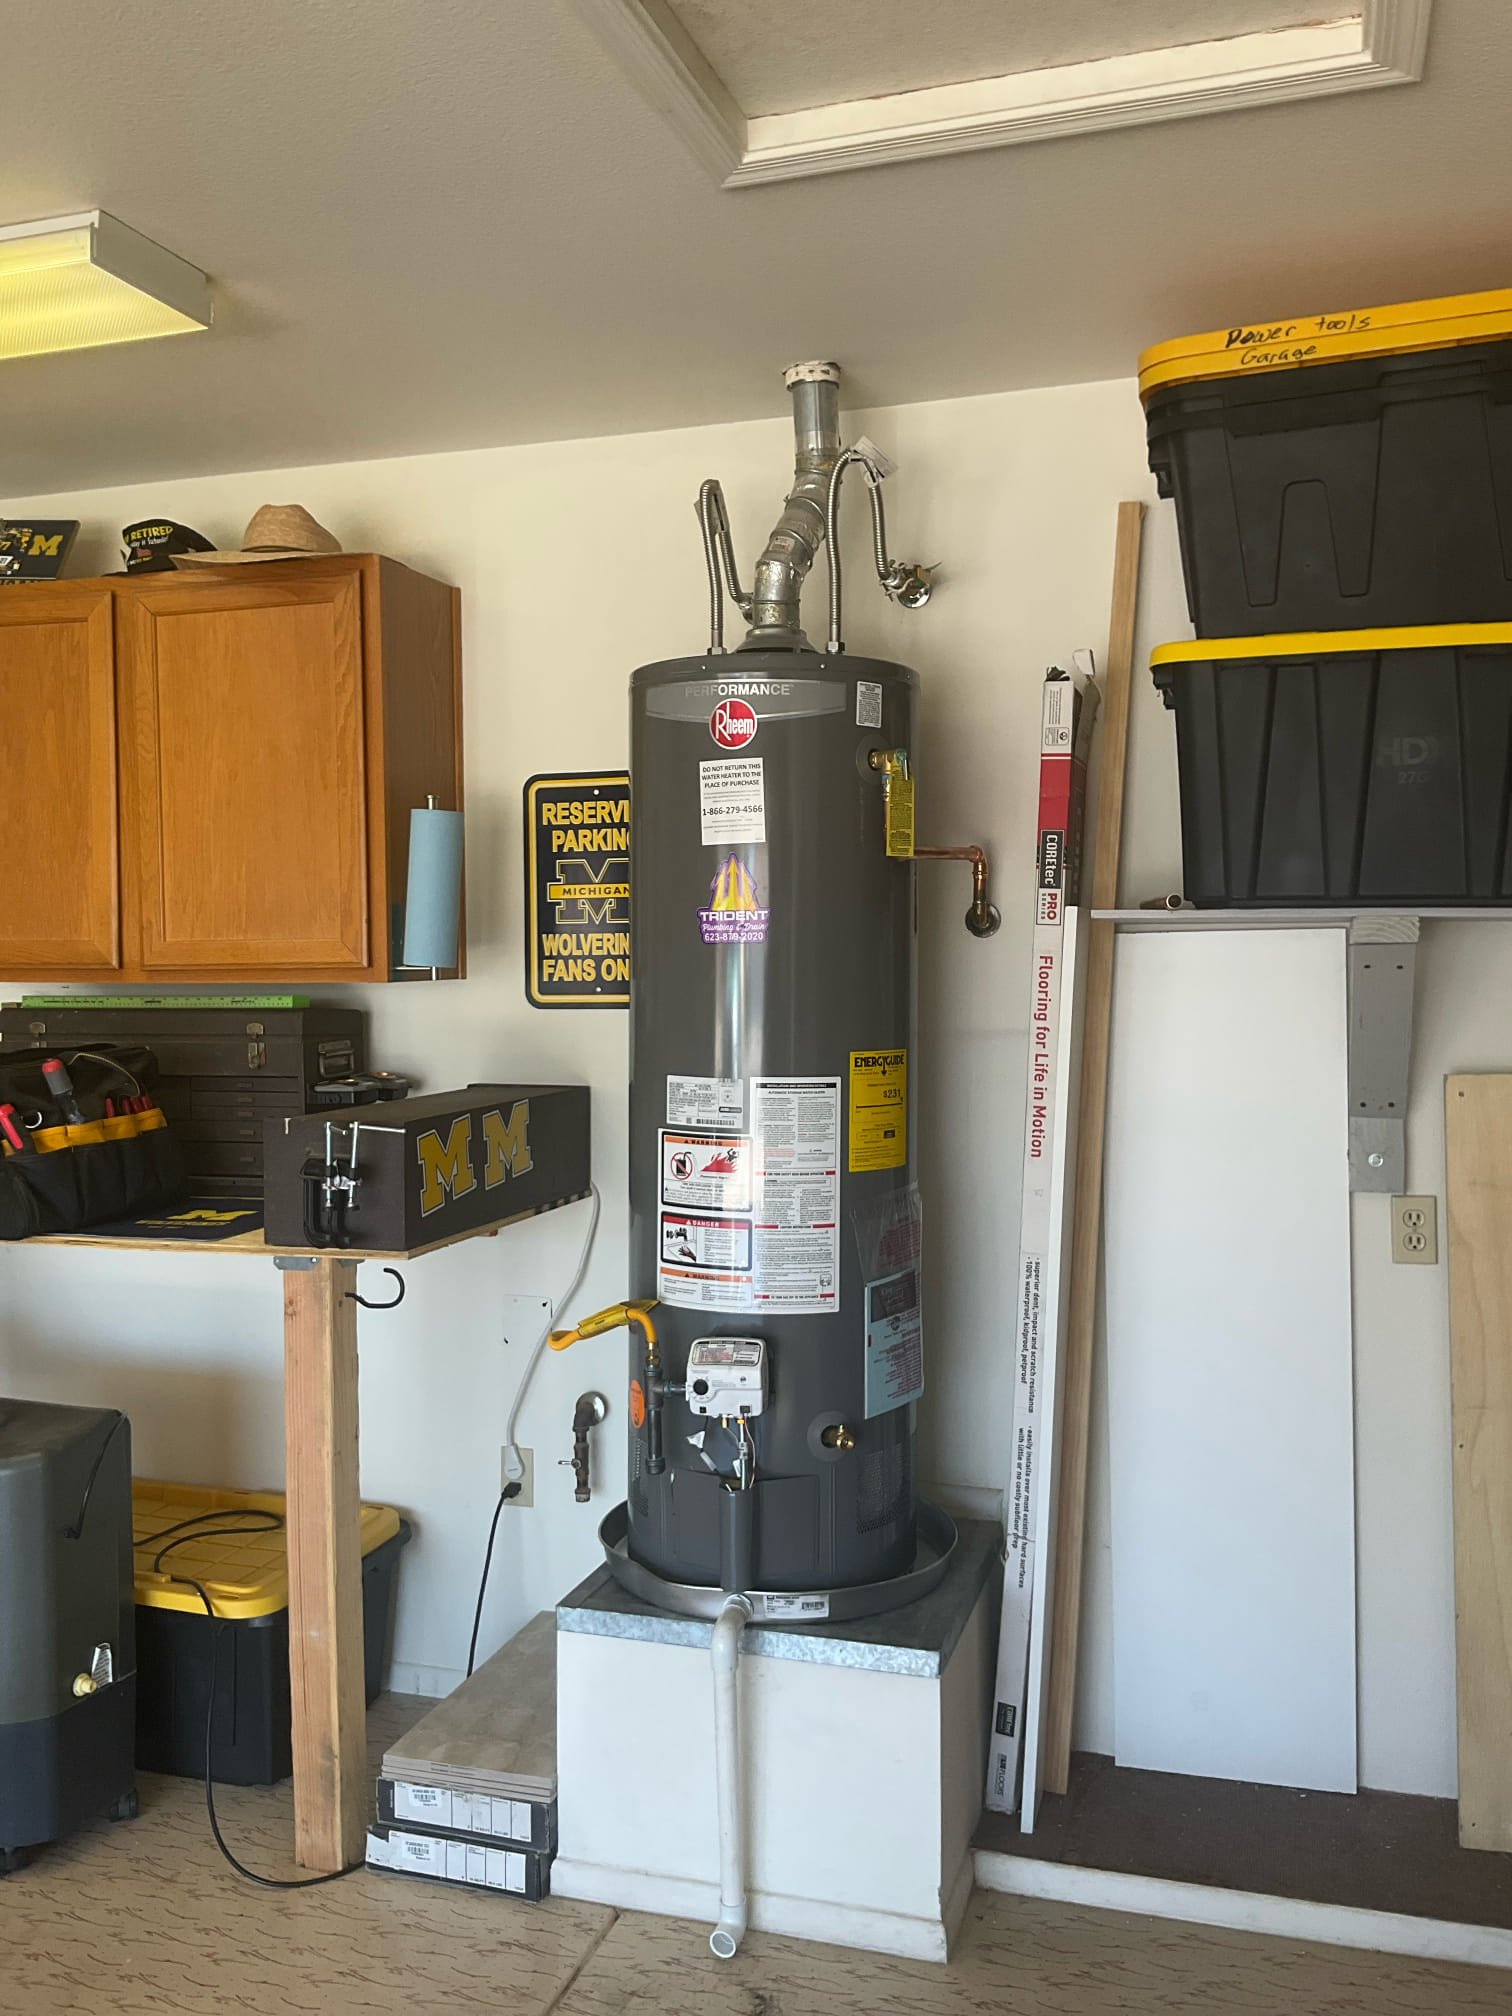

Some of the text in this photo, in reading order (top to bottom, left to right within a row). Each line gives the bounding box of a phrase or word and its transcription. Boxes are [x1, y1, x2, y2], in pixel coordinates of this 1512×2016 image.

[1314, 314, 1371, 332] tools
[1241, 345, 1317, 365] Garage
[131, 525, 174, 541] RETIRED
[28, 534, 64, 556] M
[685, 683, 791, 697] PERFORMANCE
[715, 701, 754, 741] Rheem
[702, 804, 763, 816] 1-866-279-4566
[552, 827, 630, 853] PARKIN
[1044, 834, 1058, 887] COREtec
[562, 886, 630, 896] MICHIGAN
[700, 910, 769, 922] TRIDENT
[1046, 892, 1058, 920] PRO
[543, 958, 597, 982] FANS
[1030, 955, 1054, 1159] Flooring for Life in Motion
[417, 1099, 533, 1217] M M
[1030, 1312, 1039, 1335] impact
[1030, 1337, 1038, 1350] and
